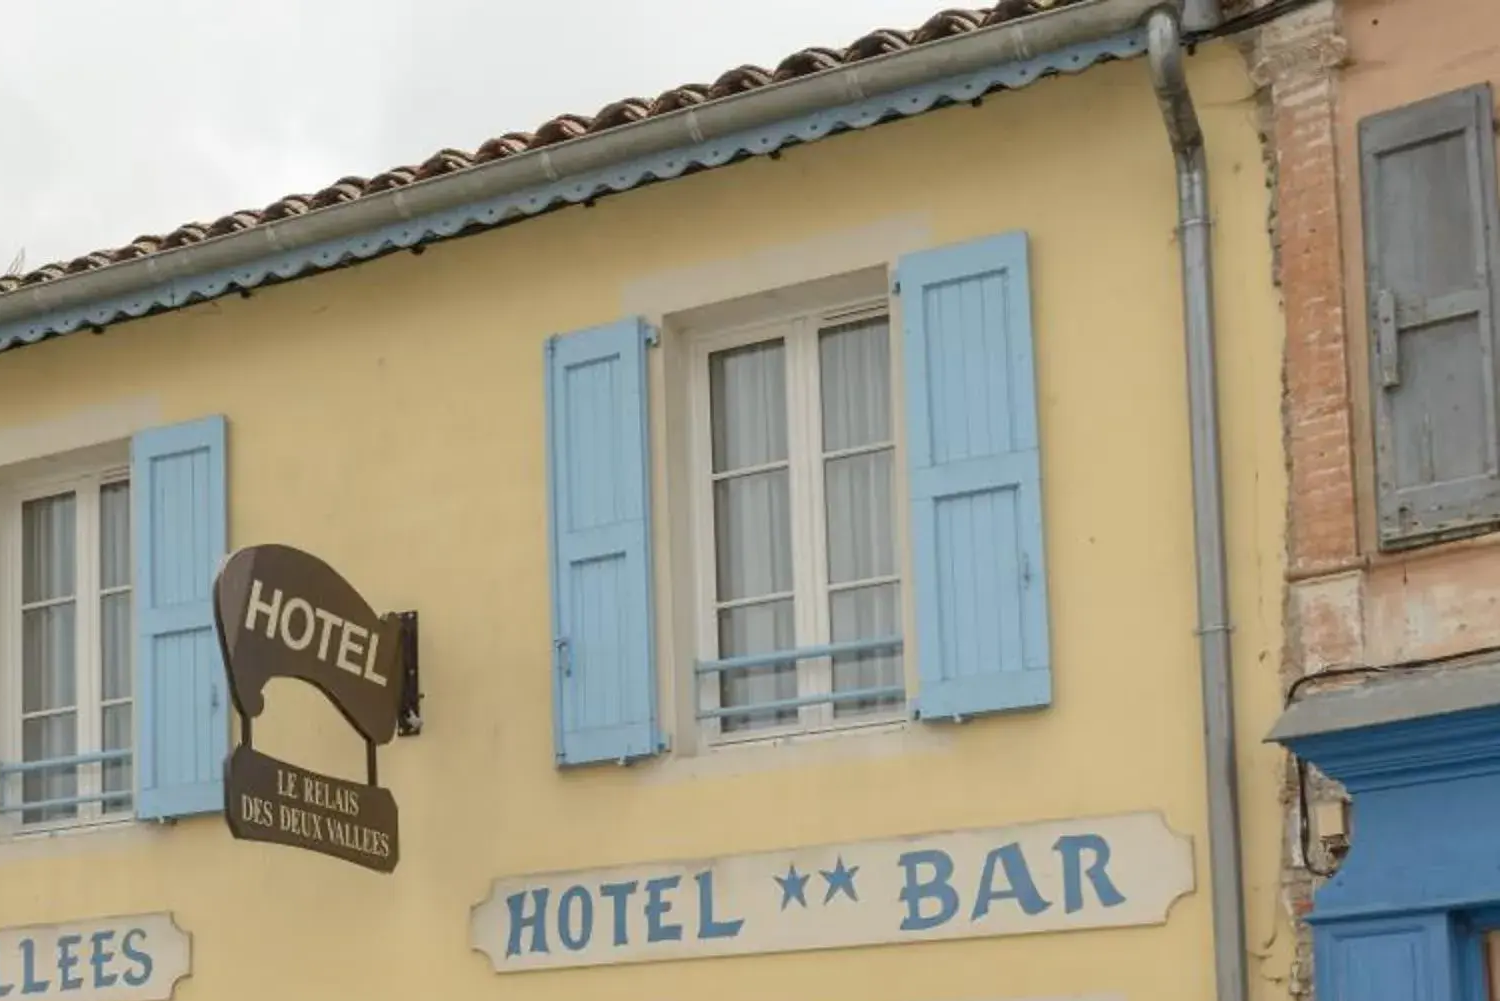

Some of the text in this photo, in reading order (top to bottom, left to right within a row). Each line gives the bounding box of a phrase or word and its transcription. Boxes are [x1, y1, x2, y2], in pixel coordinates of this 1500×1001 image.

[245, 579, 388, 687] HOTEL
[241, 793, 390, 857] DES DEUX VALLEES
[277, 769, 360, 817] LE RELAIS
[505, 832, 1128, 960] HOTEL BAR
